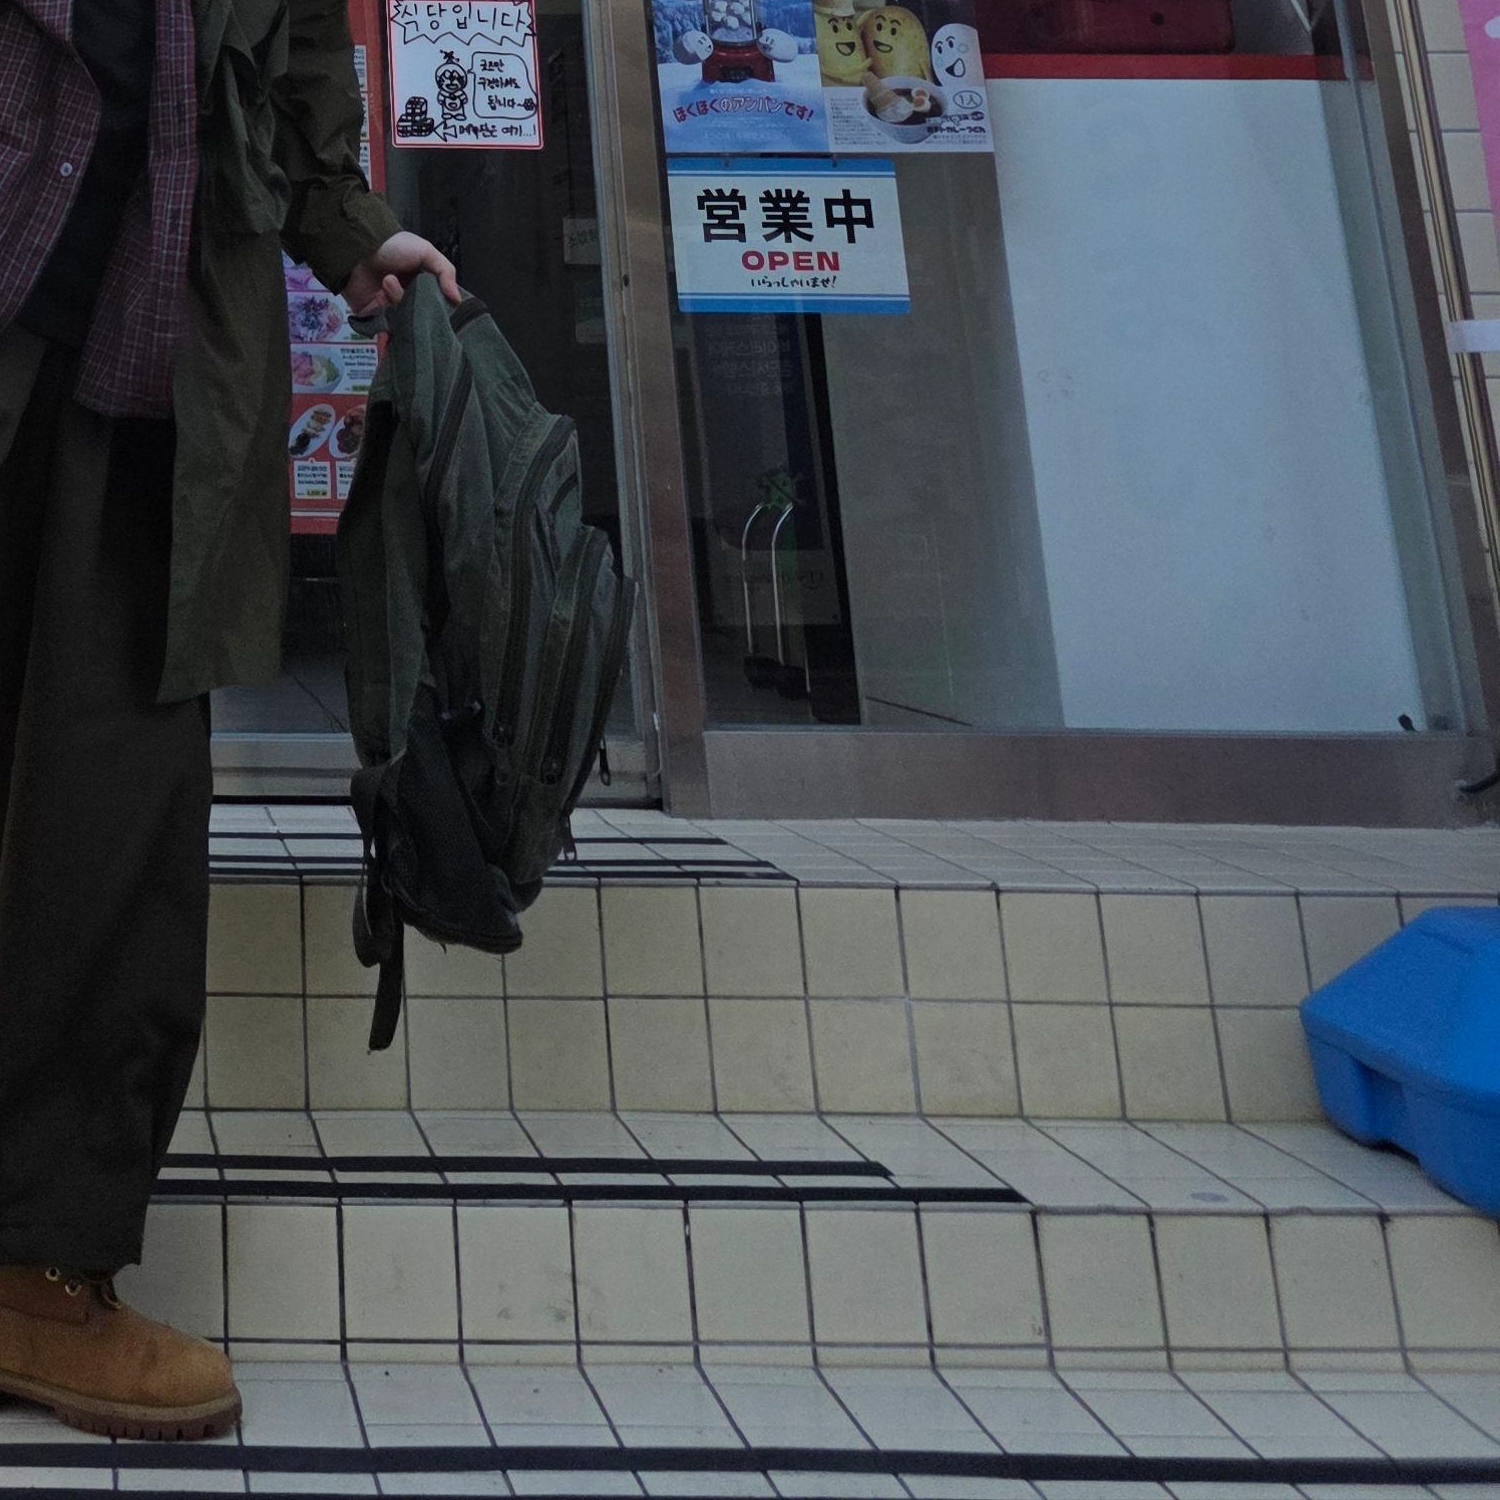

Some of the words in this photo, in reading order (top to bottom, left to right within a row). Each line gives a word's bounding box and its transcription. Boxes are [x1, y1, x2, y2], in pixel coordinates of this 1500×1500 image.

[400, 1, 529, 34] 식당입니다
[696, 187, 875, 244] 営業中
[740, 250, 840, 272] OPEN
[750, 274, 837, 289] いらっしゃいませ!
